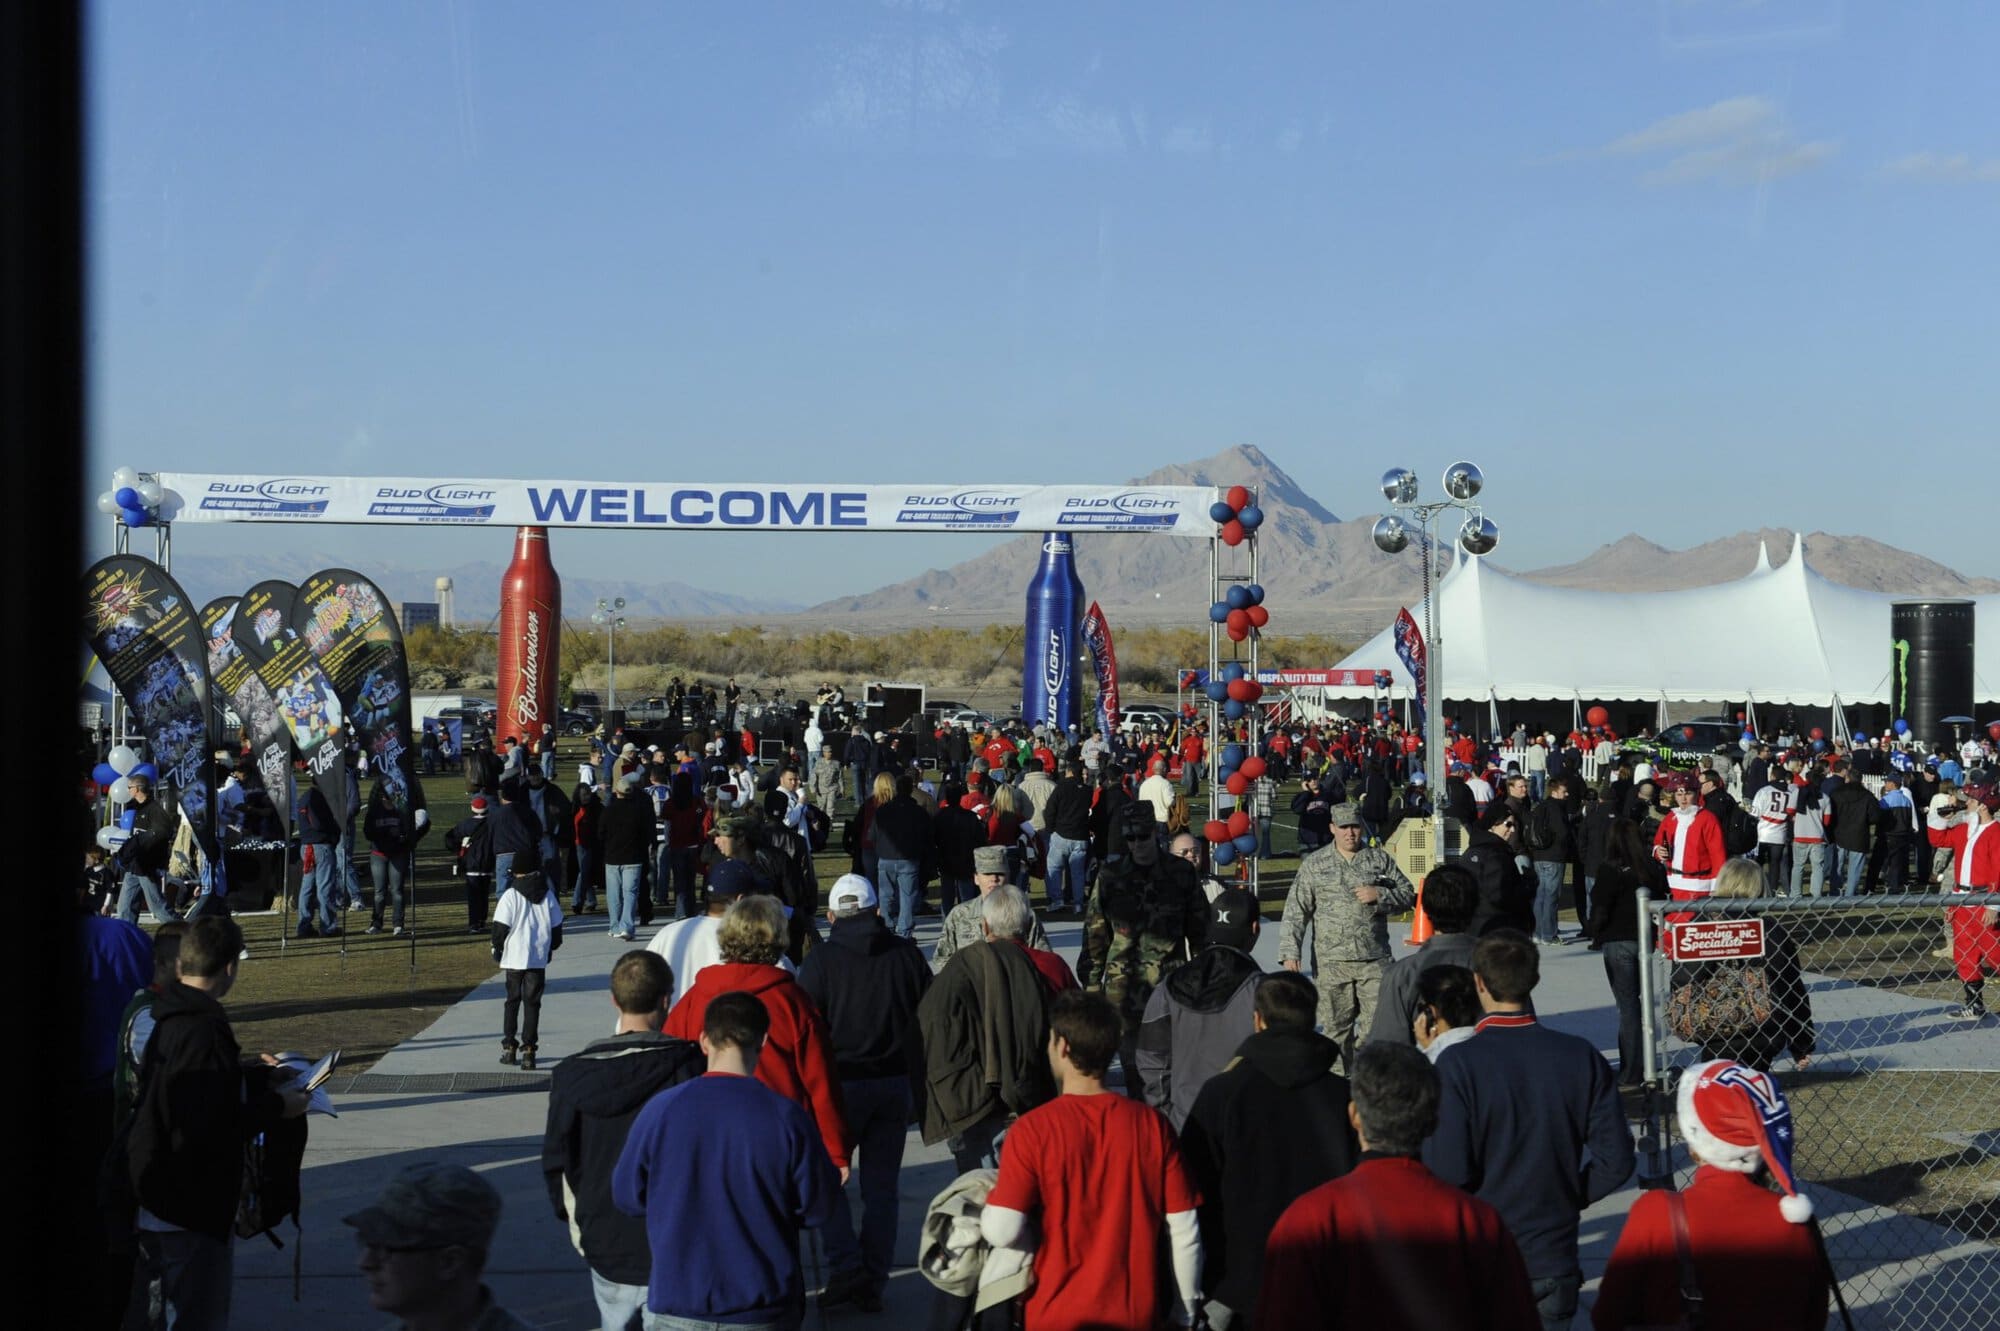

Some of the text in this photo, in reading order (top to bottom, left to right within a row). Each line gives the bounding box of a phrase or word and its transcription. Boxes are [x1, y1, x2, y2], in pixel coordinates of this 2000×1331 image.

[208, 483, 330, 495] BUD LIGHT
[376, 488, 496, 500] BUD LIGHT
[527, 488, 867, 526] WELCOME
[904, 496, 1021, 506] BUD LIGHT
[1065, 498, 1180, 509] BUD LIGHT
[518, 611, 540, 725] Budweiser
[1047, 628, 1060, 730] BUD LIGHT
[1307, 674, 1328, 684] TENT
[257, 750, 287, 775] Vegas
[307, 748, 342, 775] Vegas
[1684, 927, 1734, 940] Fencing
[1679, 937, 1743, 952] Specialists
